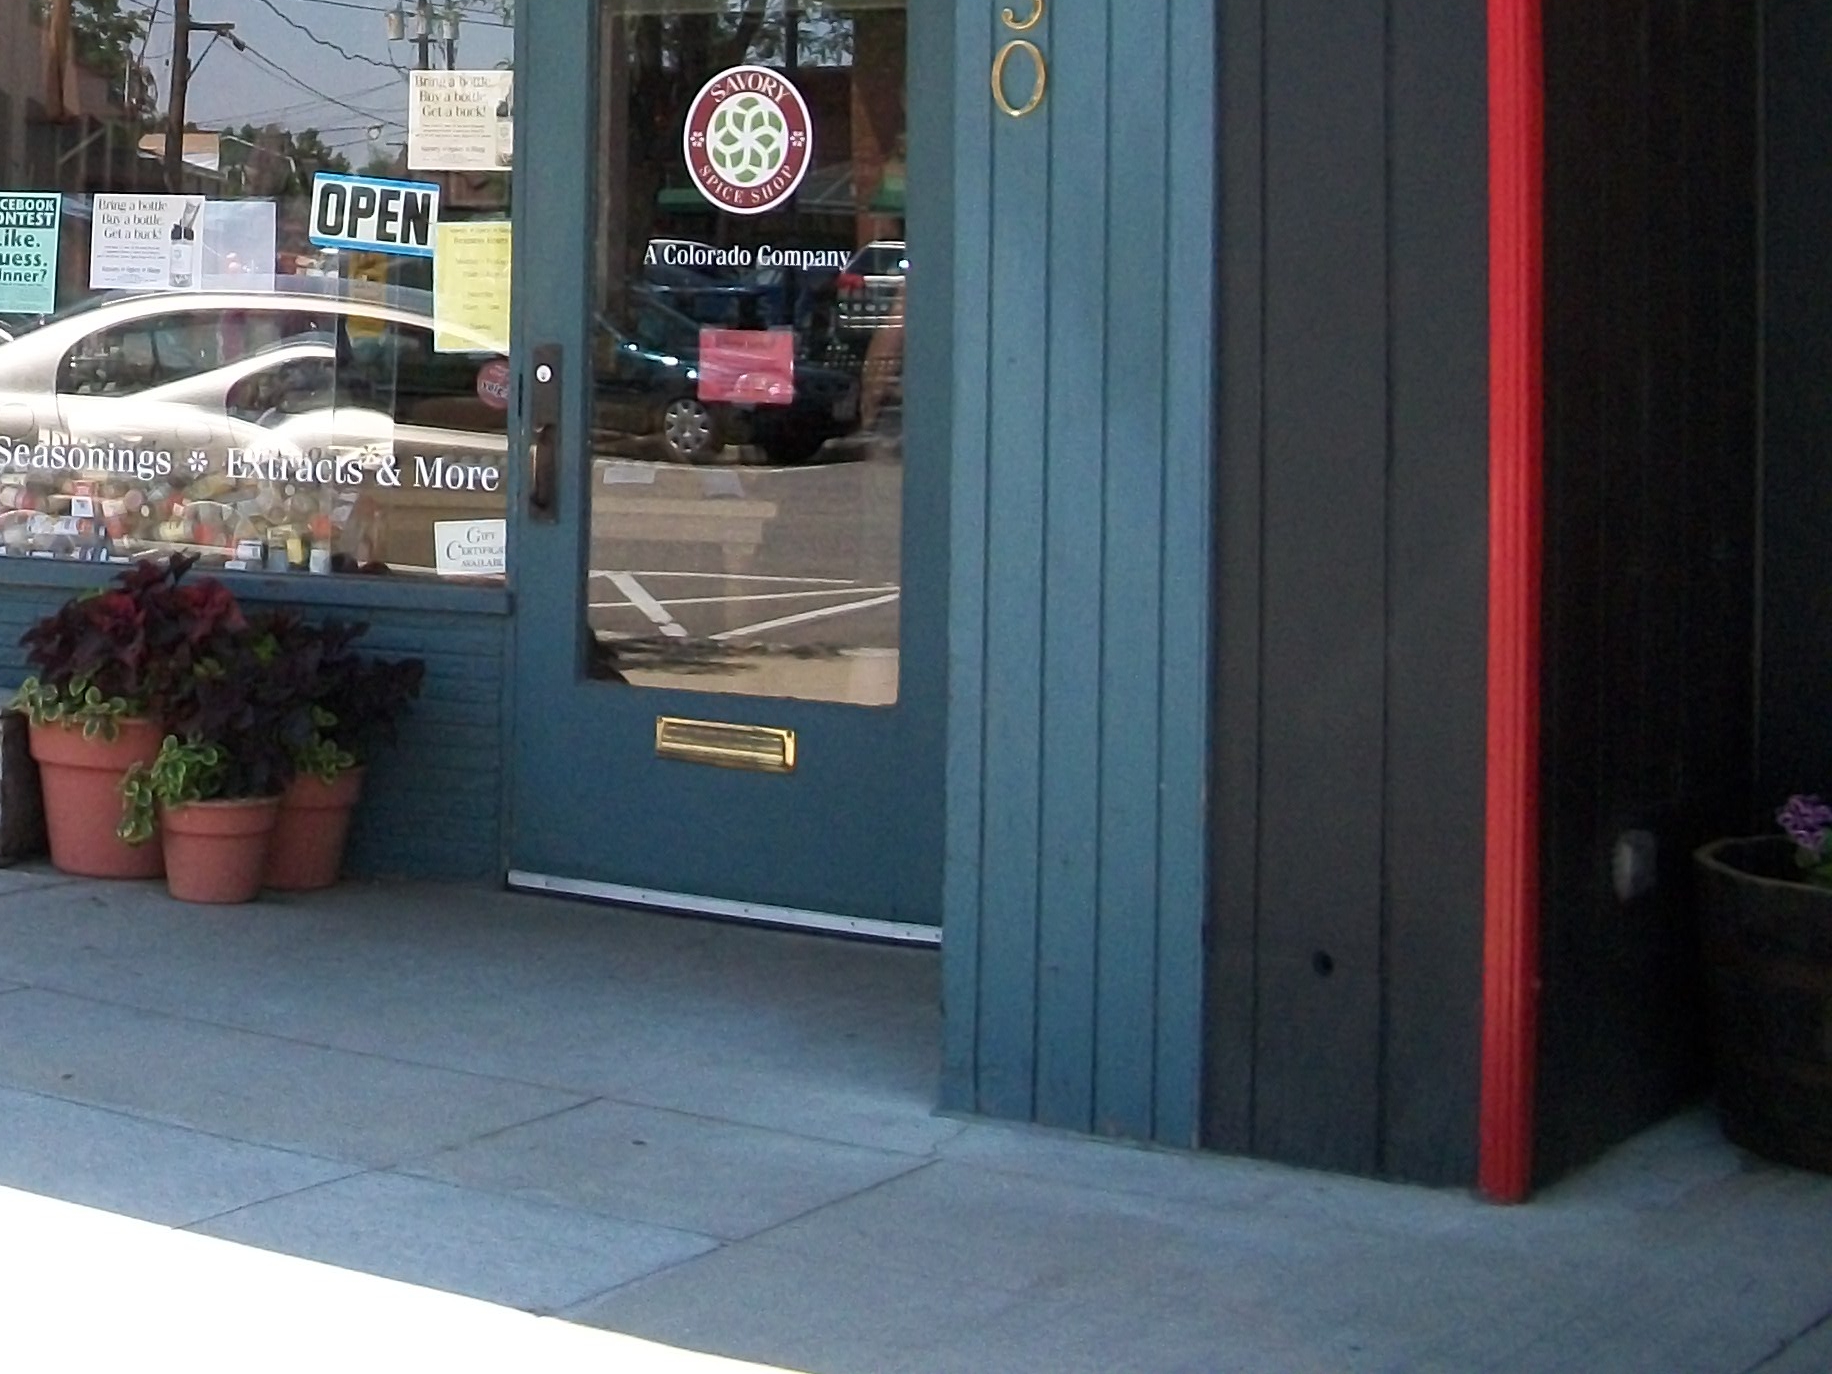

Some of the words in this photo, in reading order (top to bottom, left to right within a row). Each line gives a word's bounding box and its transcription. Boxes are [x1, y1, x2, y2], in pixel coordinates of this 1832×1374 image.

[710, 72, 790, 103] SAVORY
[422, 106, 442, 117] Get
[455, 106, 486, 117] buck!
[699, 164, 744, 204] SPICE
[751, 164, 793, 204] SHOP
[98, 198, 127, 211] Bring
[316, 182, 432, 246] OPEN
[102, 213, 121, 226] Buy
[104, 228, 122, 239] Get
[643, 244, 657, 265] A
[664, 244, 752, 266] Colorado
[757, 245, 852, 272] Company
[225, 447, 365, 485] Extracts
[374, 455, 402, 487] &
[412, 457, 500, 491] More
